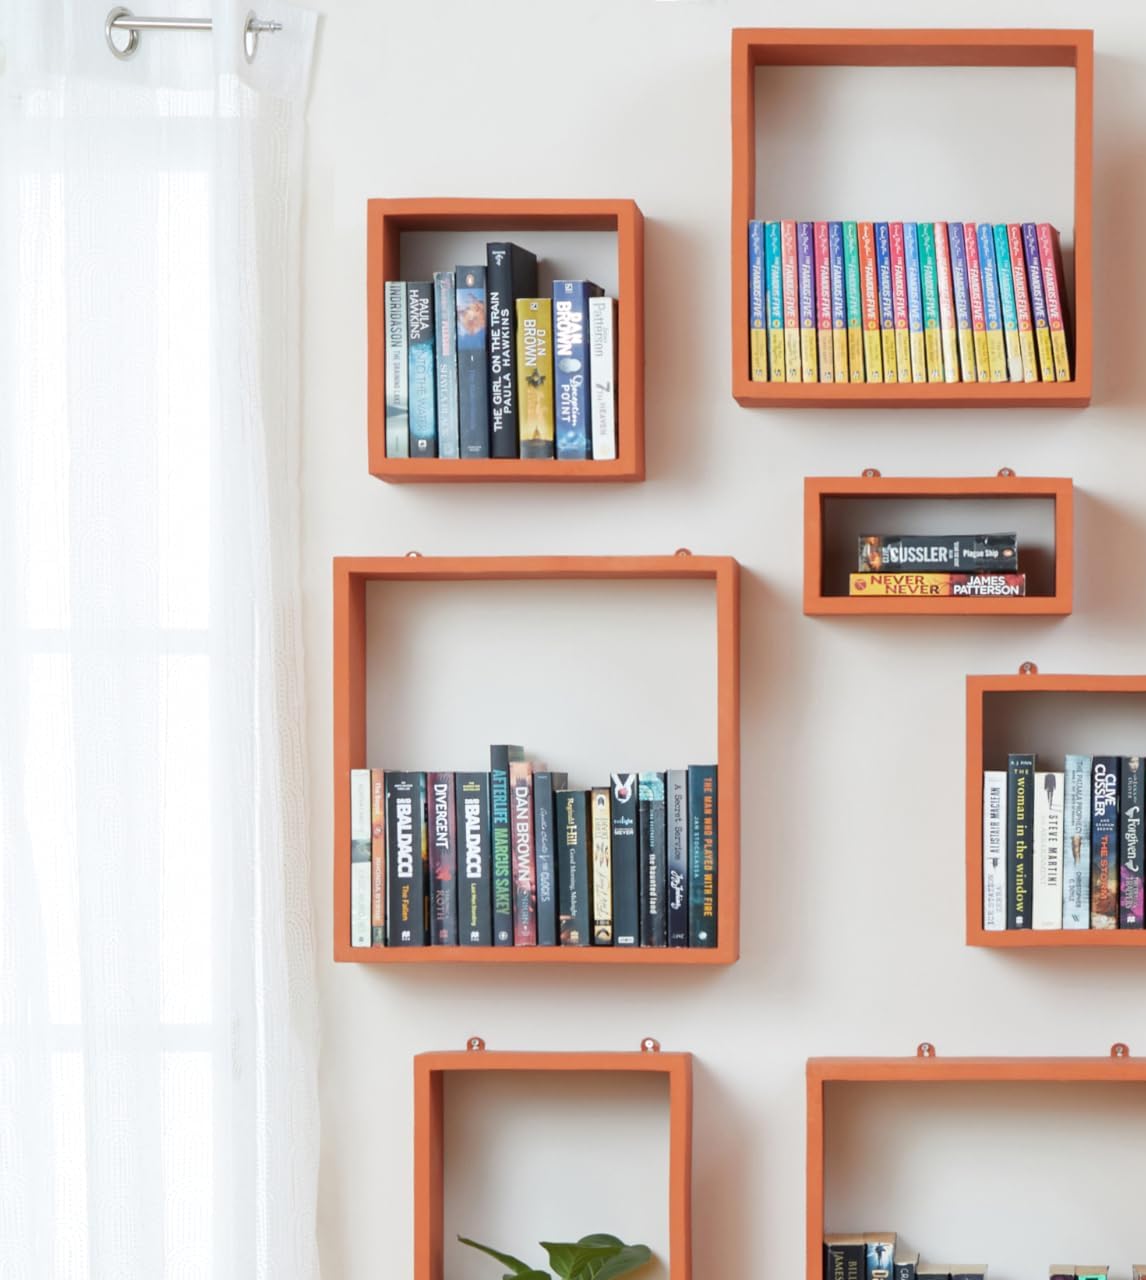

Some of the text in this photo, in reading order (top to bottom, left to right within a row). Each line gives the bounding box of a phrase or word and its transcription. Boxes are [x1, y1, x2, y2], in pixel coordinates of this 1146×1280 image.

[409, 290, 421, 339] HAWKINS
[419, 298, 430, 330] PAULA
[556, 300, 583, 356] DAN BROWN
[523, 319, 546, 367] DAN BROWN
[490, 292, 503, 432] THE GIRL ON THE TRAIN
[501, 308, 512, 414] PAULA HAWKINS
[561, 384, 571, 423] POINT
[889, 545, 948, 563] CUSSLER
[985, 548, 999, 558] Ship
[871, 576, 924, 585] NEVER
[885, 585, 940, 594] NEVER
[953, 585, 1019, 596] PATTERSON
[966, 576, 1006, 586] JAMES
[1016, 777, 1026, 821] woman
[1094, 764, 1106, 817] CUSSLER
[1105, 773, 1117, 806] CLIVE
[434, 784, 449, 849] DIVERGENT
[674, 795, 683, 823] Secret
[397, 804, 413, 878] BALDACCI
[465, 804, 482, 878] BALDACCI
[493, 770, 510, 915] AFTERLIFE MARCUS SAKEY
[515, 786, 532, 880] DAN BROWN
[566, 825, 579, 846] Hill
[704, 778, 713, 917] THE MAN WHO PLAYED WITH FIRE
[1016, 824, 1028, 837] in
[1125, 818, 1141, 860] Forgiven
[649, 853, 657, 865] the
[1016, 841, 1028, 859] the
[1047, 815, 1058, 886] STEVE MARTINI
[540, 871, 551, 903] CLOCKS
[649, 866, 658, 896] haunted
[1016, 863, 1028, 912] window
[1100, 859, 1109, 900] STORM
[401, 885, 410, 921] The Fallen
[436, 890, 446, 920] ROTH
[650, 897, 658, 914] land
[834, 1251, 844, 1280] JAMES
[848, 1261, 857, 1280] BILL
